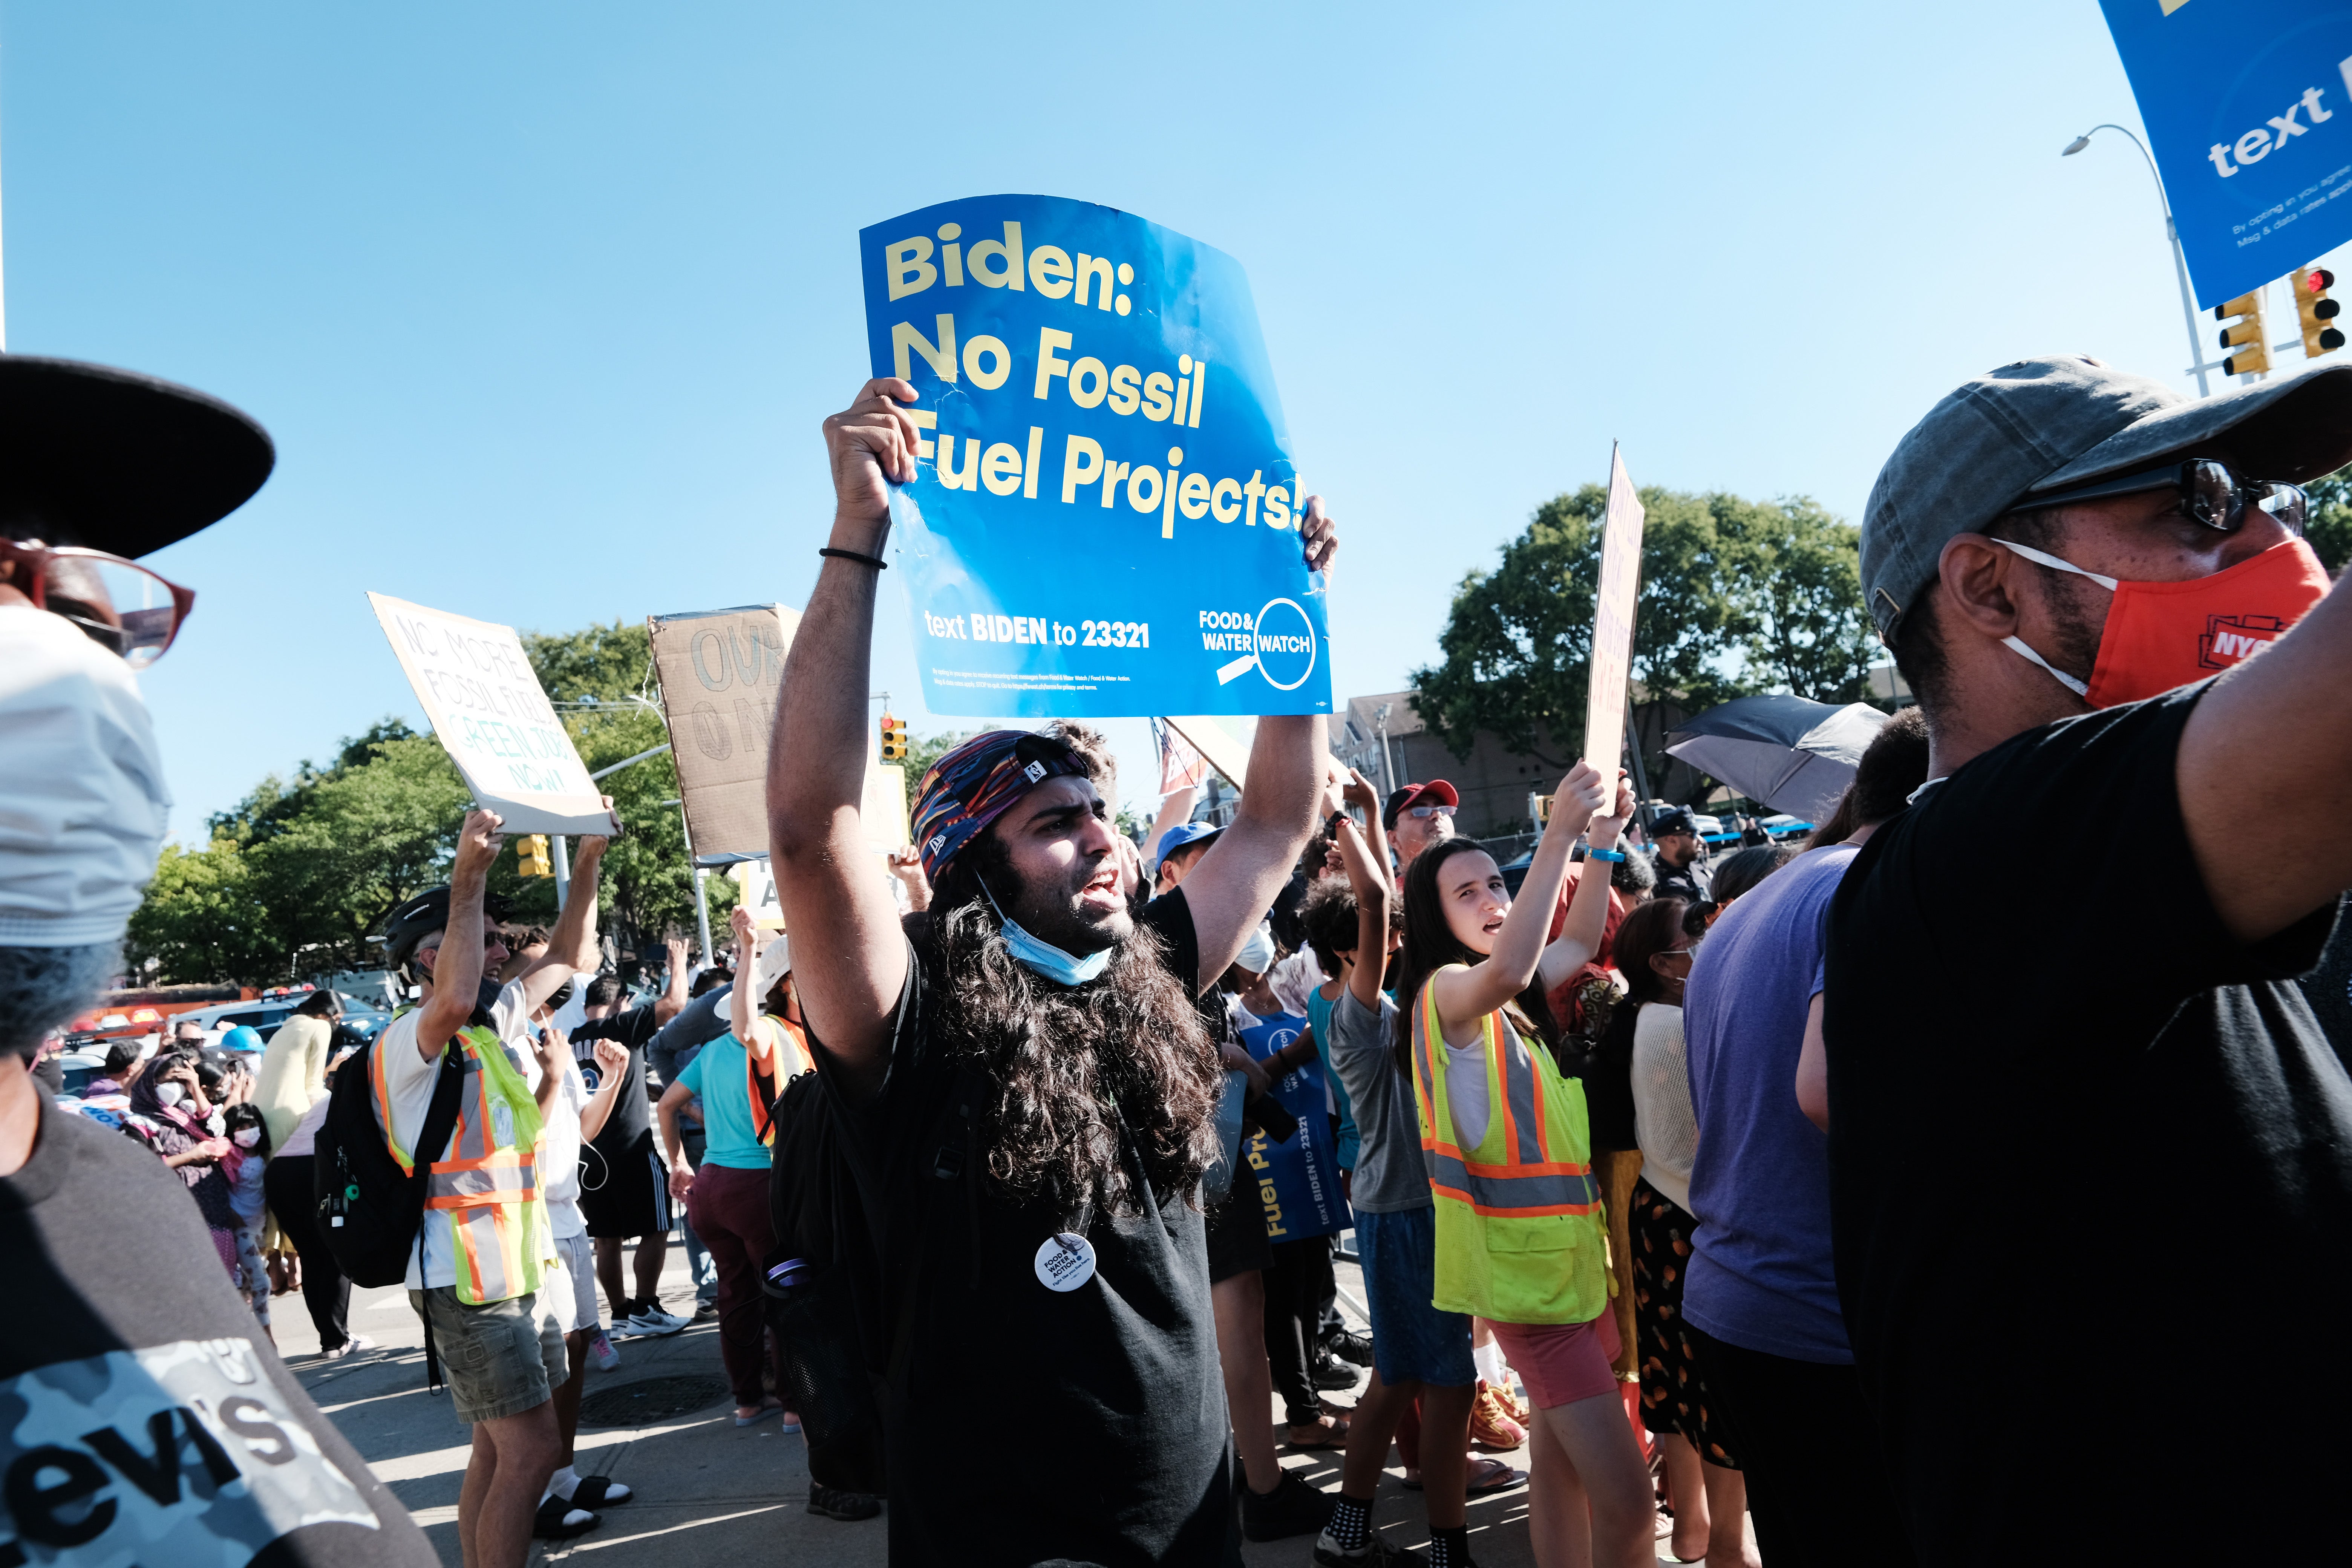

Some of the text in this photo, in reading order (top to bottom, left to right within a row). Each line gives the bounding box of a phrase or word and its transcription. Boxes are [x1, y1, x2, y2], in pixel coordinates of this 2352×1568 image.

[2208, 87, 2333, 178] text
[2233, 165, 2352, 234] By opting in you agree
[2237, 233, 2260, 248] Msg
[2263, 226, 2271, 235] &
[2273, 213, 2298, 229] data
[2300, 196, 2327, 215] rates
[886, 221, 1134, 316] Biden:
[891, 313, 1205, 429] No Fossil
[1061, 434, 1303, 539] Projects!
[396, 615, 528, 681] NO MORE
[924, 610, 1149, 648] text BIDEN to 23321
[1202, 632, 1310, 653] WATER WATCH
[423, 669, 507, 716] FOSSIL
[449, 714, 537, 760] GREEN
[508, 763, 567, 793] NOW!
[1298, 1116, 1329, 1225] text BIDEN to 23321
[1259, 1178, 1287, 1237] Fuel
[1044, 1253, 1062, 1268] FOOD
[1048, 1256, 1070, 1272] WATER
[1053, 1258, 1076, 1278] ACTION
